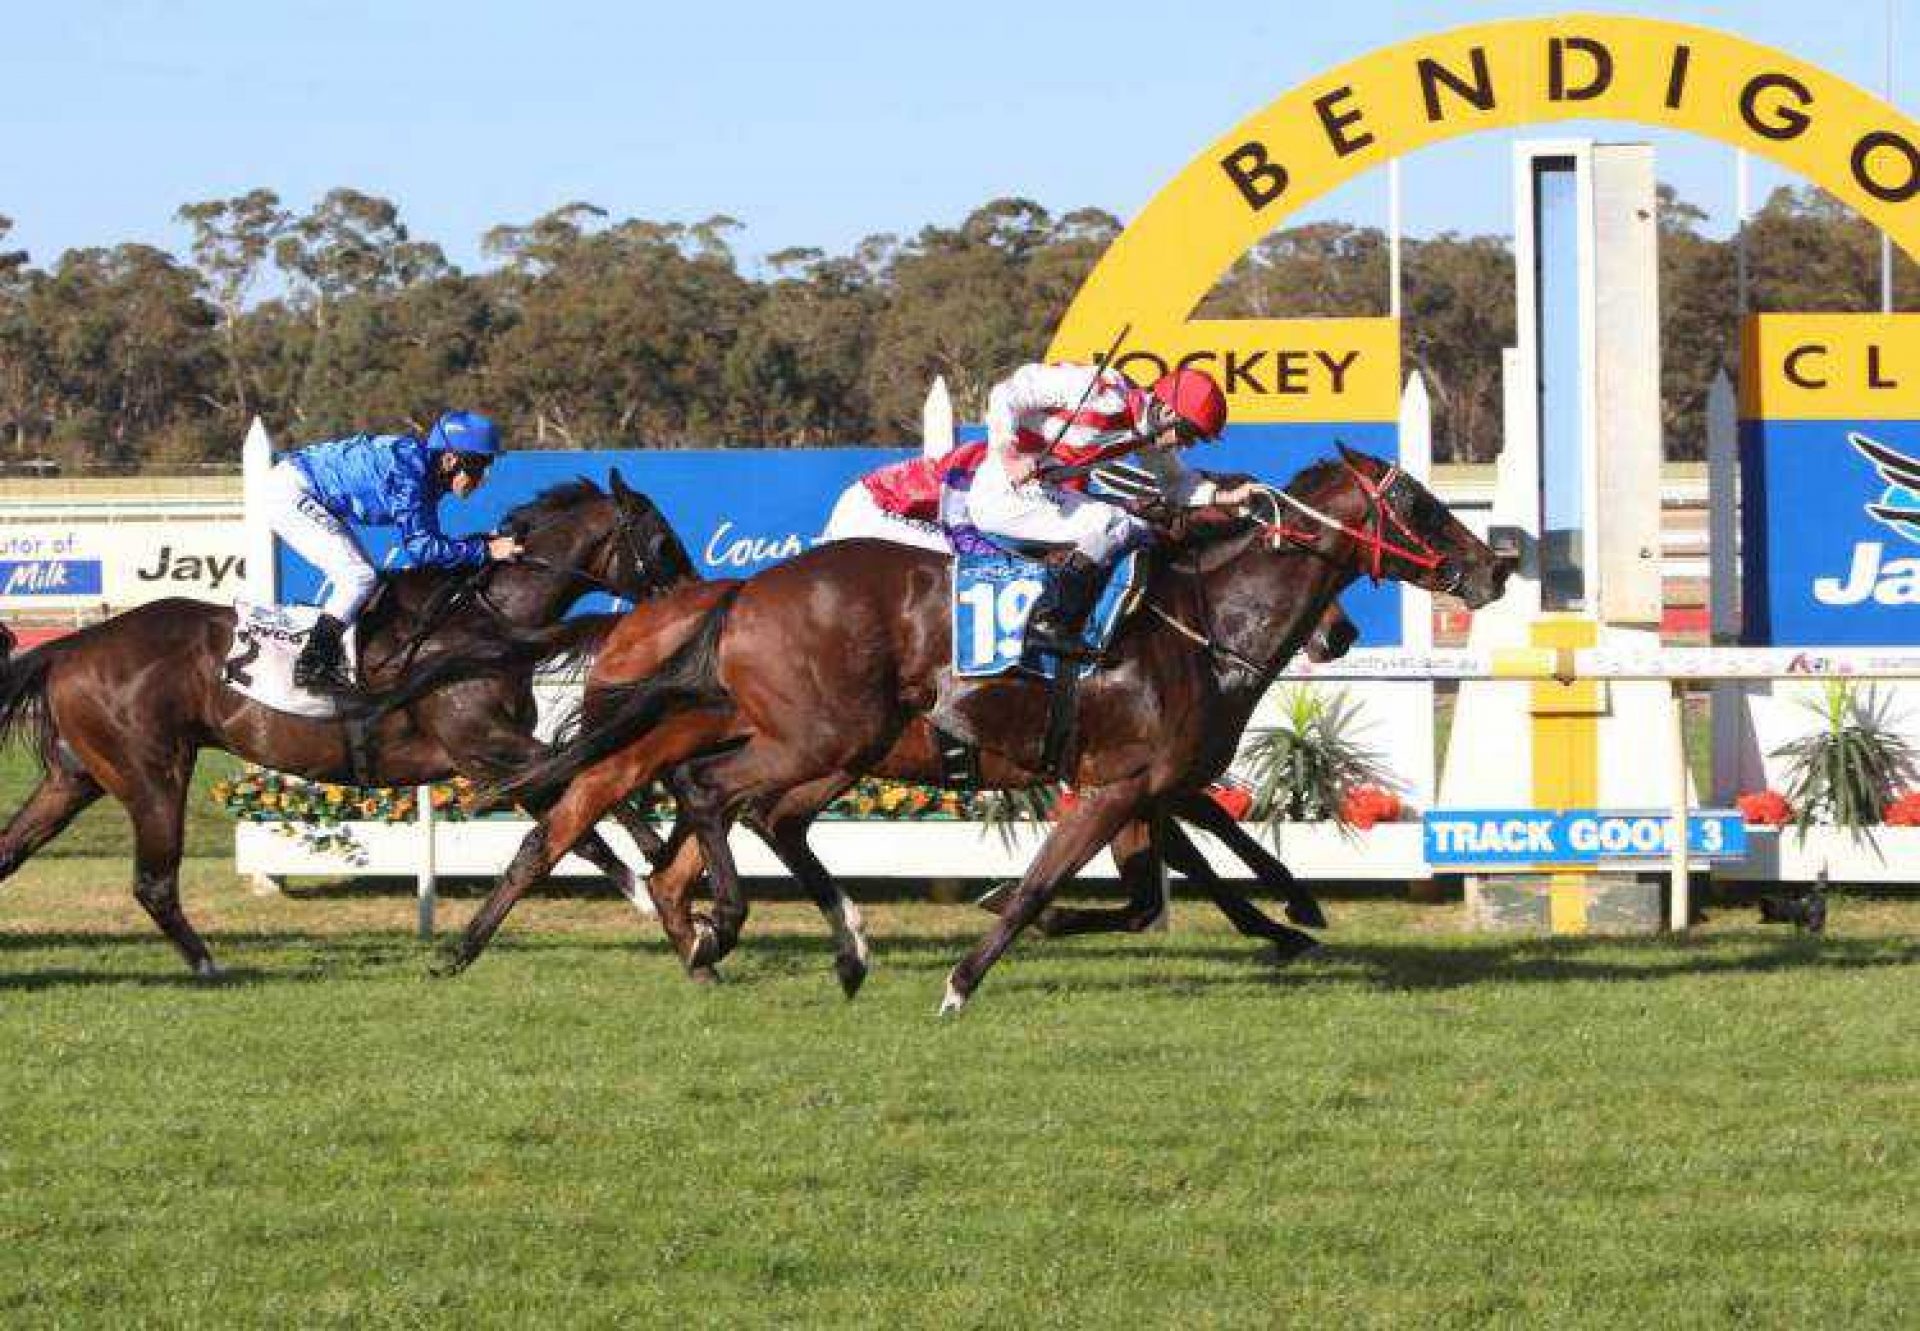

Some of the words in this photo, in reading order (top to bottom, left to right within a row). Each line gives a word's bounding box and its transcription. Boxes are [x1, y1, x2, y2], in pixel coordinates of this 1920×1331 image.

[1220, 37, 1920, 211] BENDIGO
[1092, 350, 1360, 394] OKEY
[1783, 345, 1898, 389] CL
[960, 579, 1043, 664] 19
[1431, 819, 1554, 853] TRACK
[1702, 819, 1723, 852] 3
